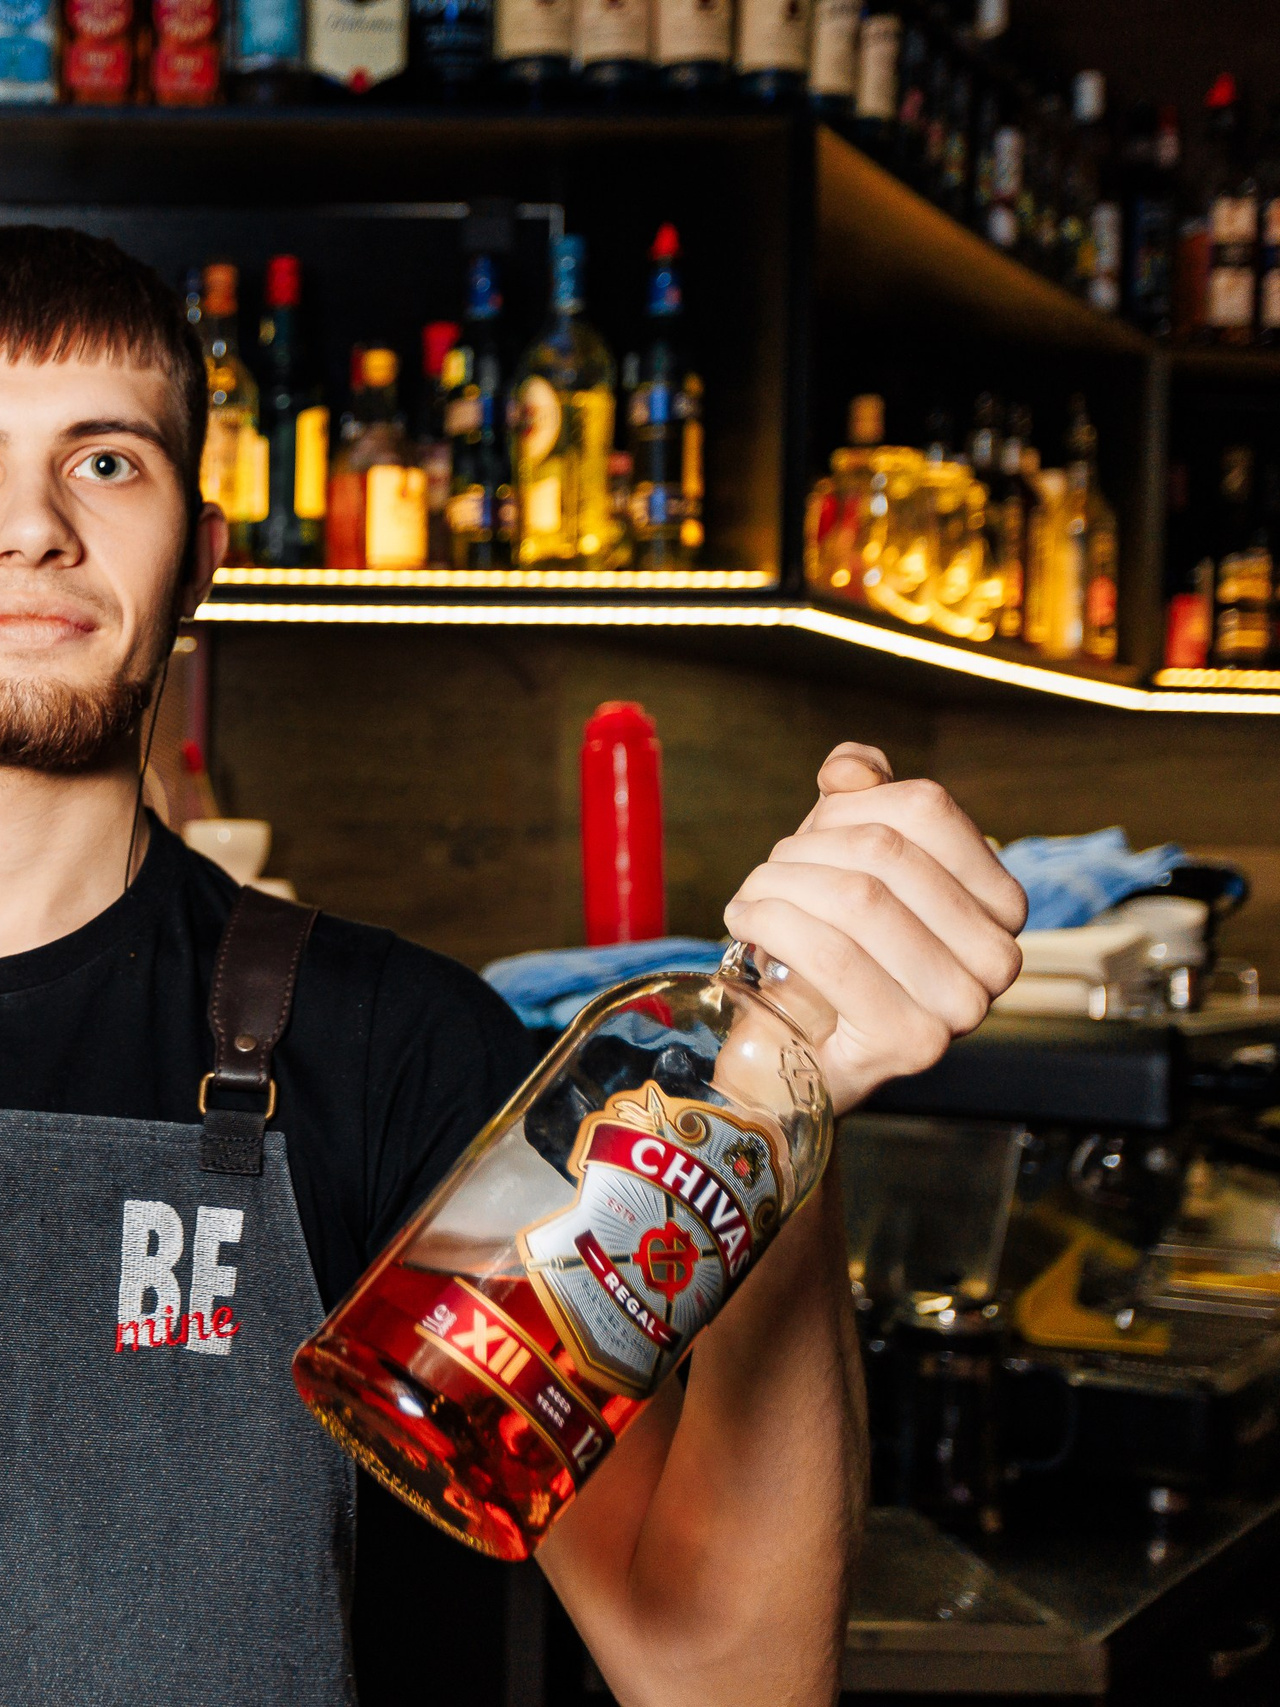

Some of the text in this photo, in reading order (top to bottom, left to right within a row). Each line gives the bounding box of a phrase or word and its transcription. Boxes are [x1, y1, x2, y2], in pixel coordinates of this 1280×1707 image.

[630, 1138, 751, 1278] CHIVAS
[117, 1199, 245, 1356] BE
[603, 1270, 656, 1336] REGAL
[115, 1304, 244, 1353] mine
[451, 1307, 532, 1387] XII
[571, 1424, 604, 1472] 12
